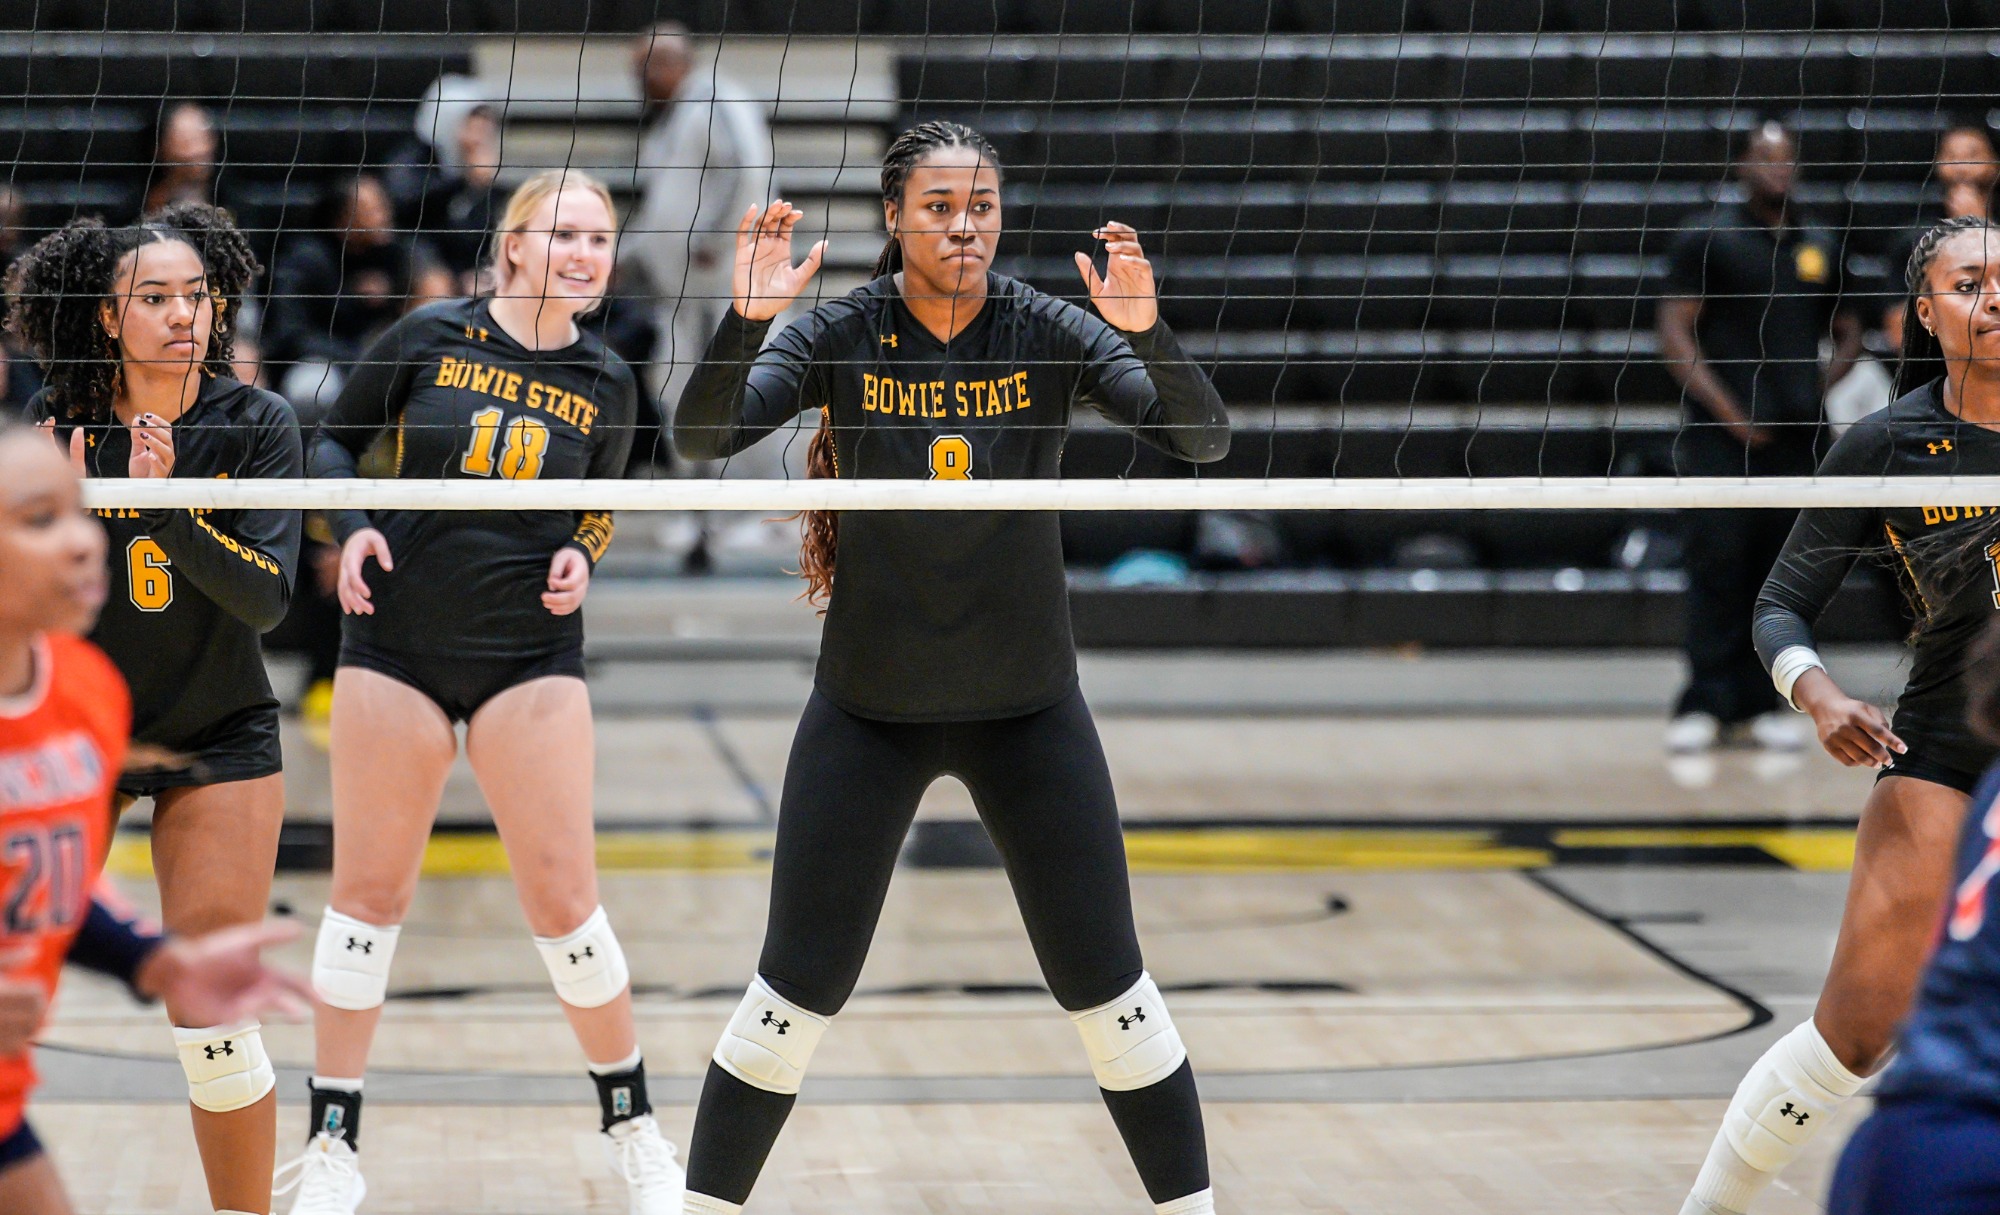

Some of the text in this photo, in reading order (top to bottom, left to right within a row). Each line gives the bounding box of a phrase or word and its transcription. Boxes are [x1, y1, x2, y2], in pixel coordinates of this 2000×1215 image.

[435, 356, 599, 435] BOWIE STATE
[862, 371, 1031, 418] BOWIE STATE
[461, 405, 550, 480] 18
[928, 434, 972, 480] 8
[126, 535, 173, 612] 6
